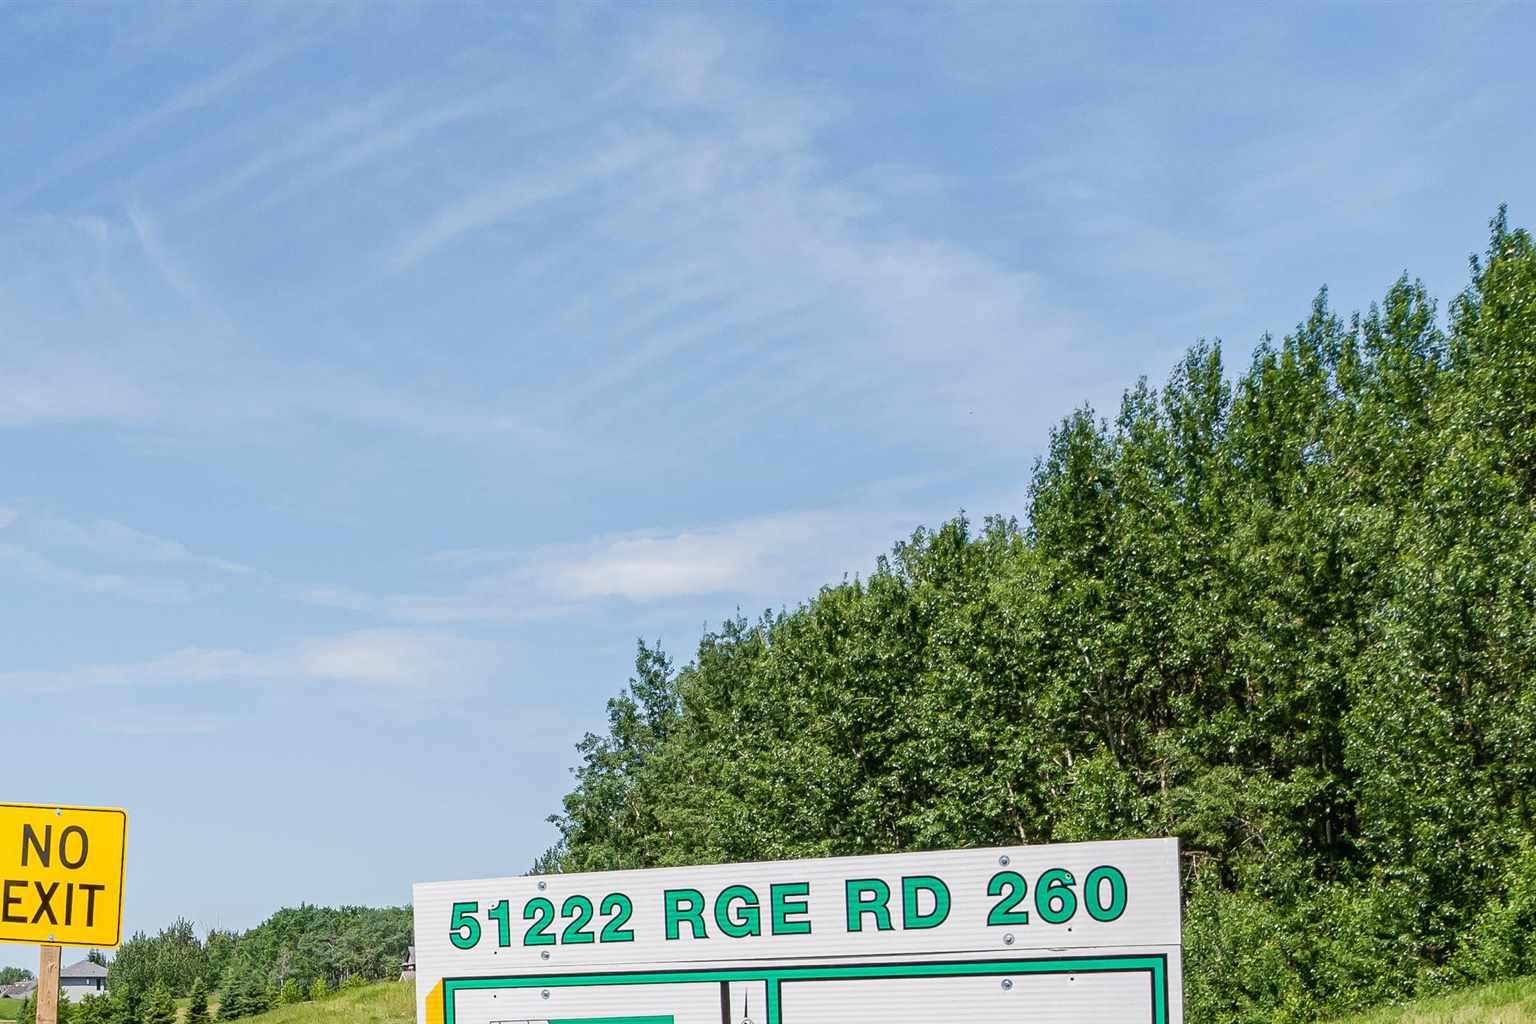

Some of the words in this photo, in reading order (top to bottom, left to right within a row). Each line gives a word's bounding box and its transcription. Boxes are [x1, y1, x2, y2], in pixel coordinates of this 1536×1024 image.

[21, 823, 89, 870] NO
[1, 879, 106, 927] EXIT
[449, 892, 635, 950] 51222
[664, 881, 812, 940] RGE
[845, 875, 951, 933] RD
[986, 865, 1128, 926] 260
